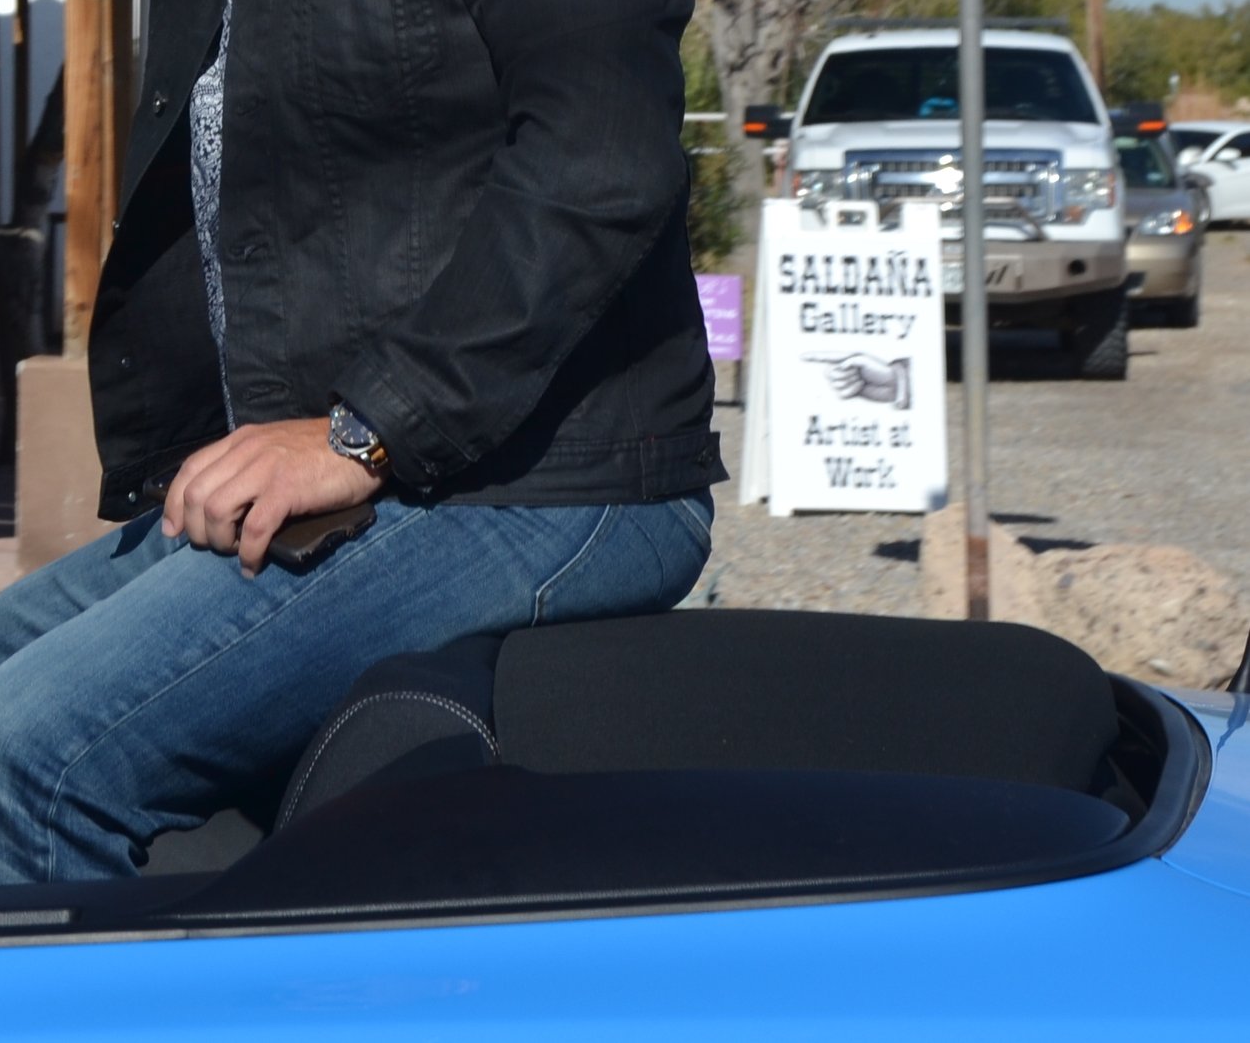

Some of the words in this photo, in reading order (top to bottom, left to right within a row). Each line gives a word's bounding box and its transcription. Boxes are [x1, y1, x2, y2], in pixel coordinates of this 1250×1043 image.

[779, 250, 933, 297] SALDAÑA
[800, 302, 917, 339] Gallery
[803, 415, 882, 446] Artist
[889, 421, 912, 447] at
[824, 457, 897, 488] Work
